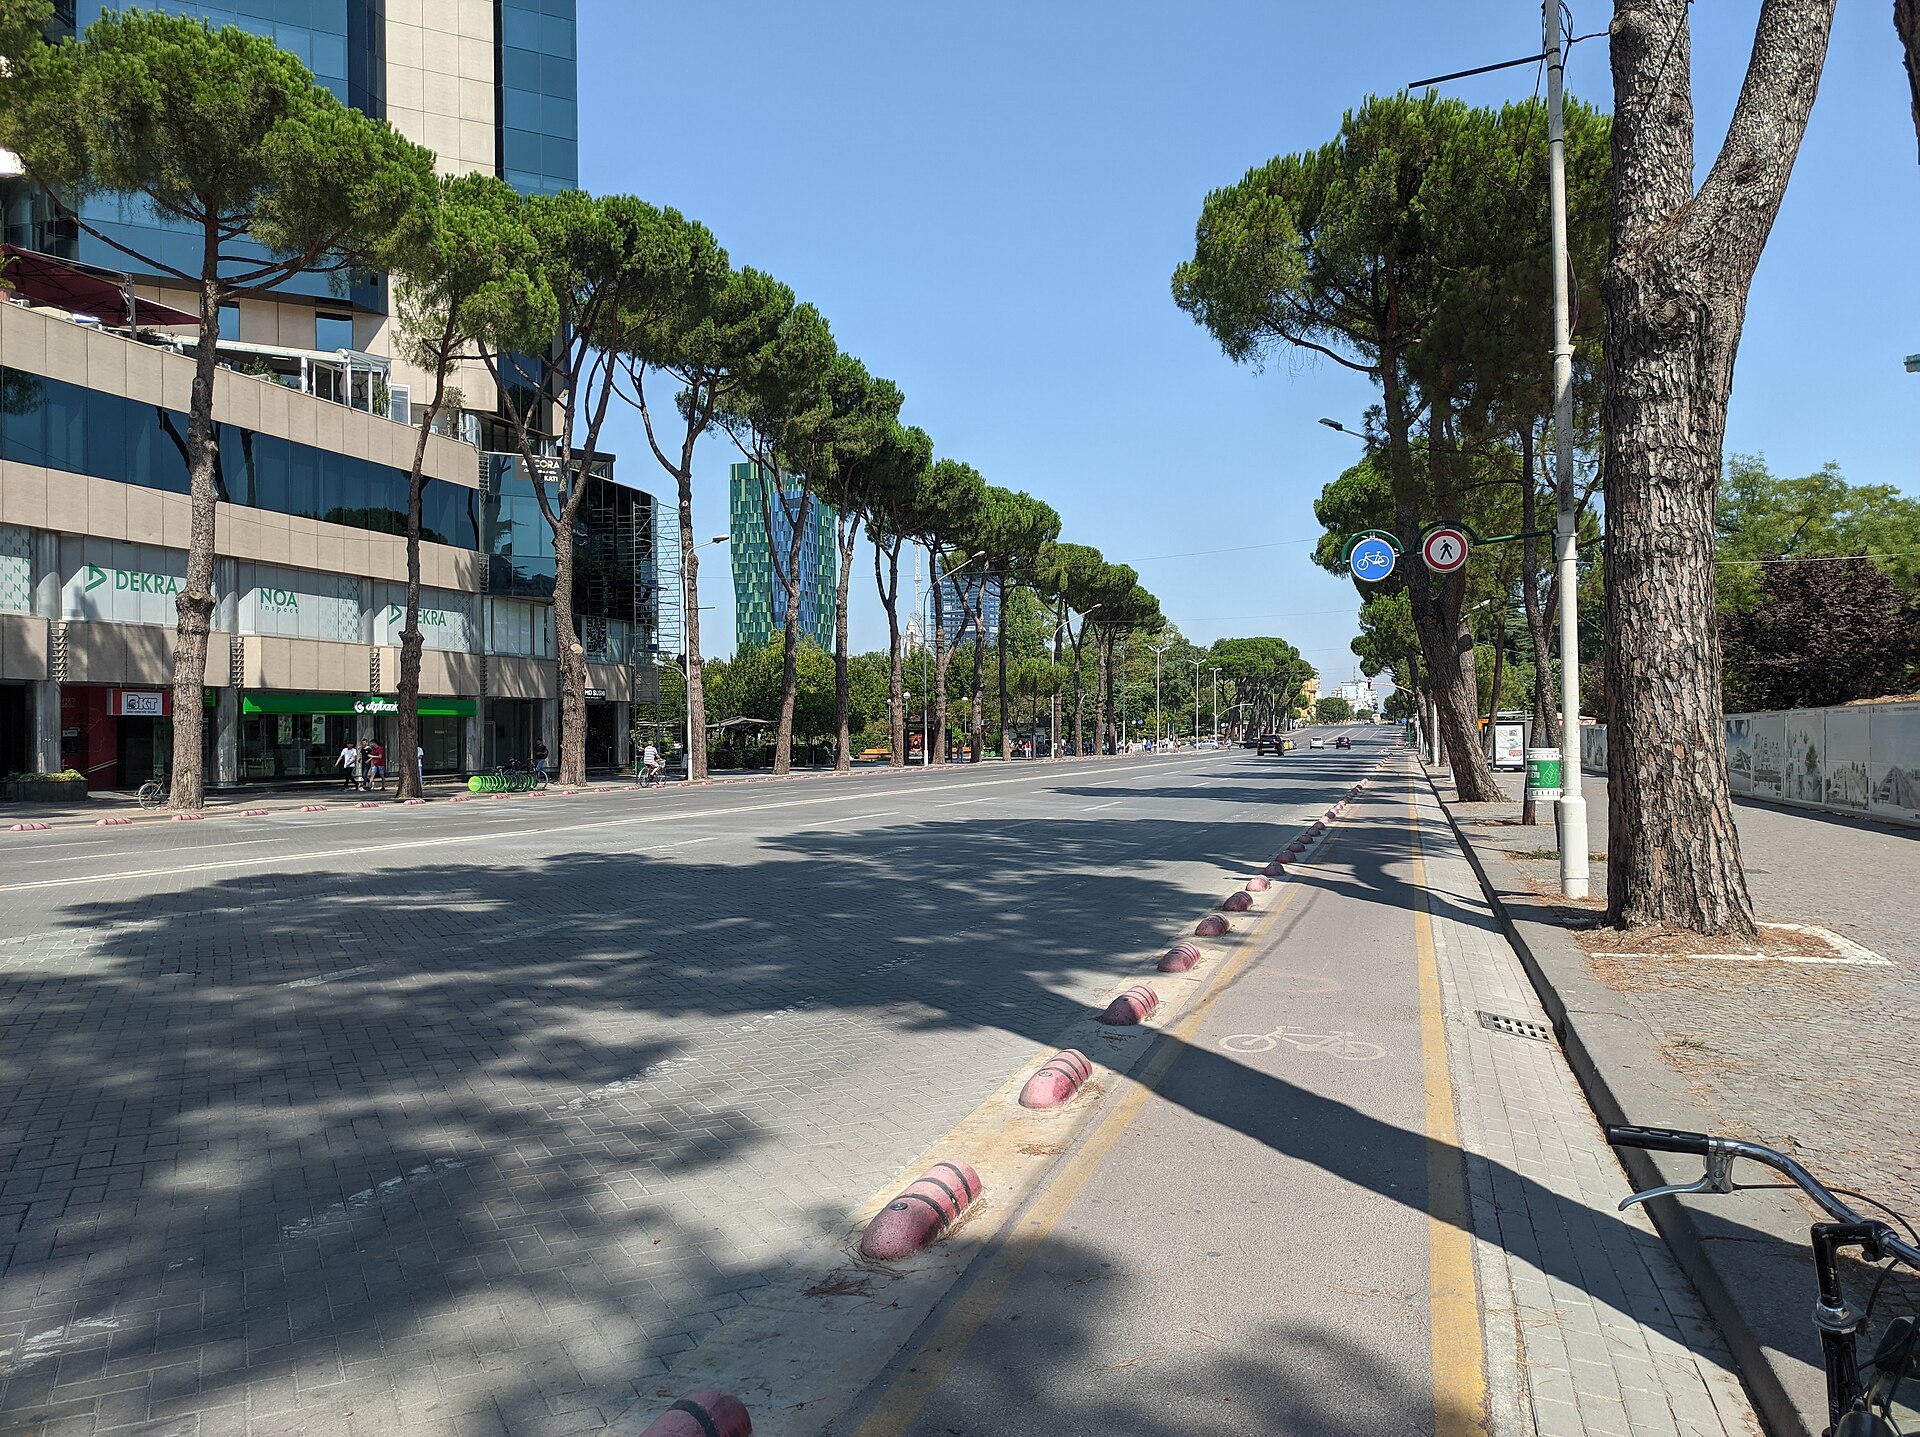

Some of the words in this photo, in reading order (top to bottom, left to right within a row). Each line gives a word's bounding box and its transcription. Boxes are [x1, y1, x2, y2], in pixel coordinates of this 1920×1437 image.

[116, 569, 178, 595] DEKRA
[260, 587, 298, 607] NOA
[417, 608, 446, 626] EKRA
[127, 694, 158, 710] BKT
